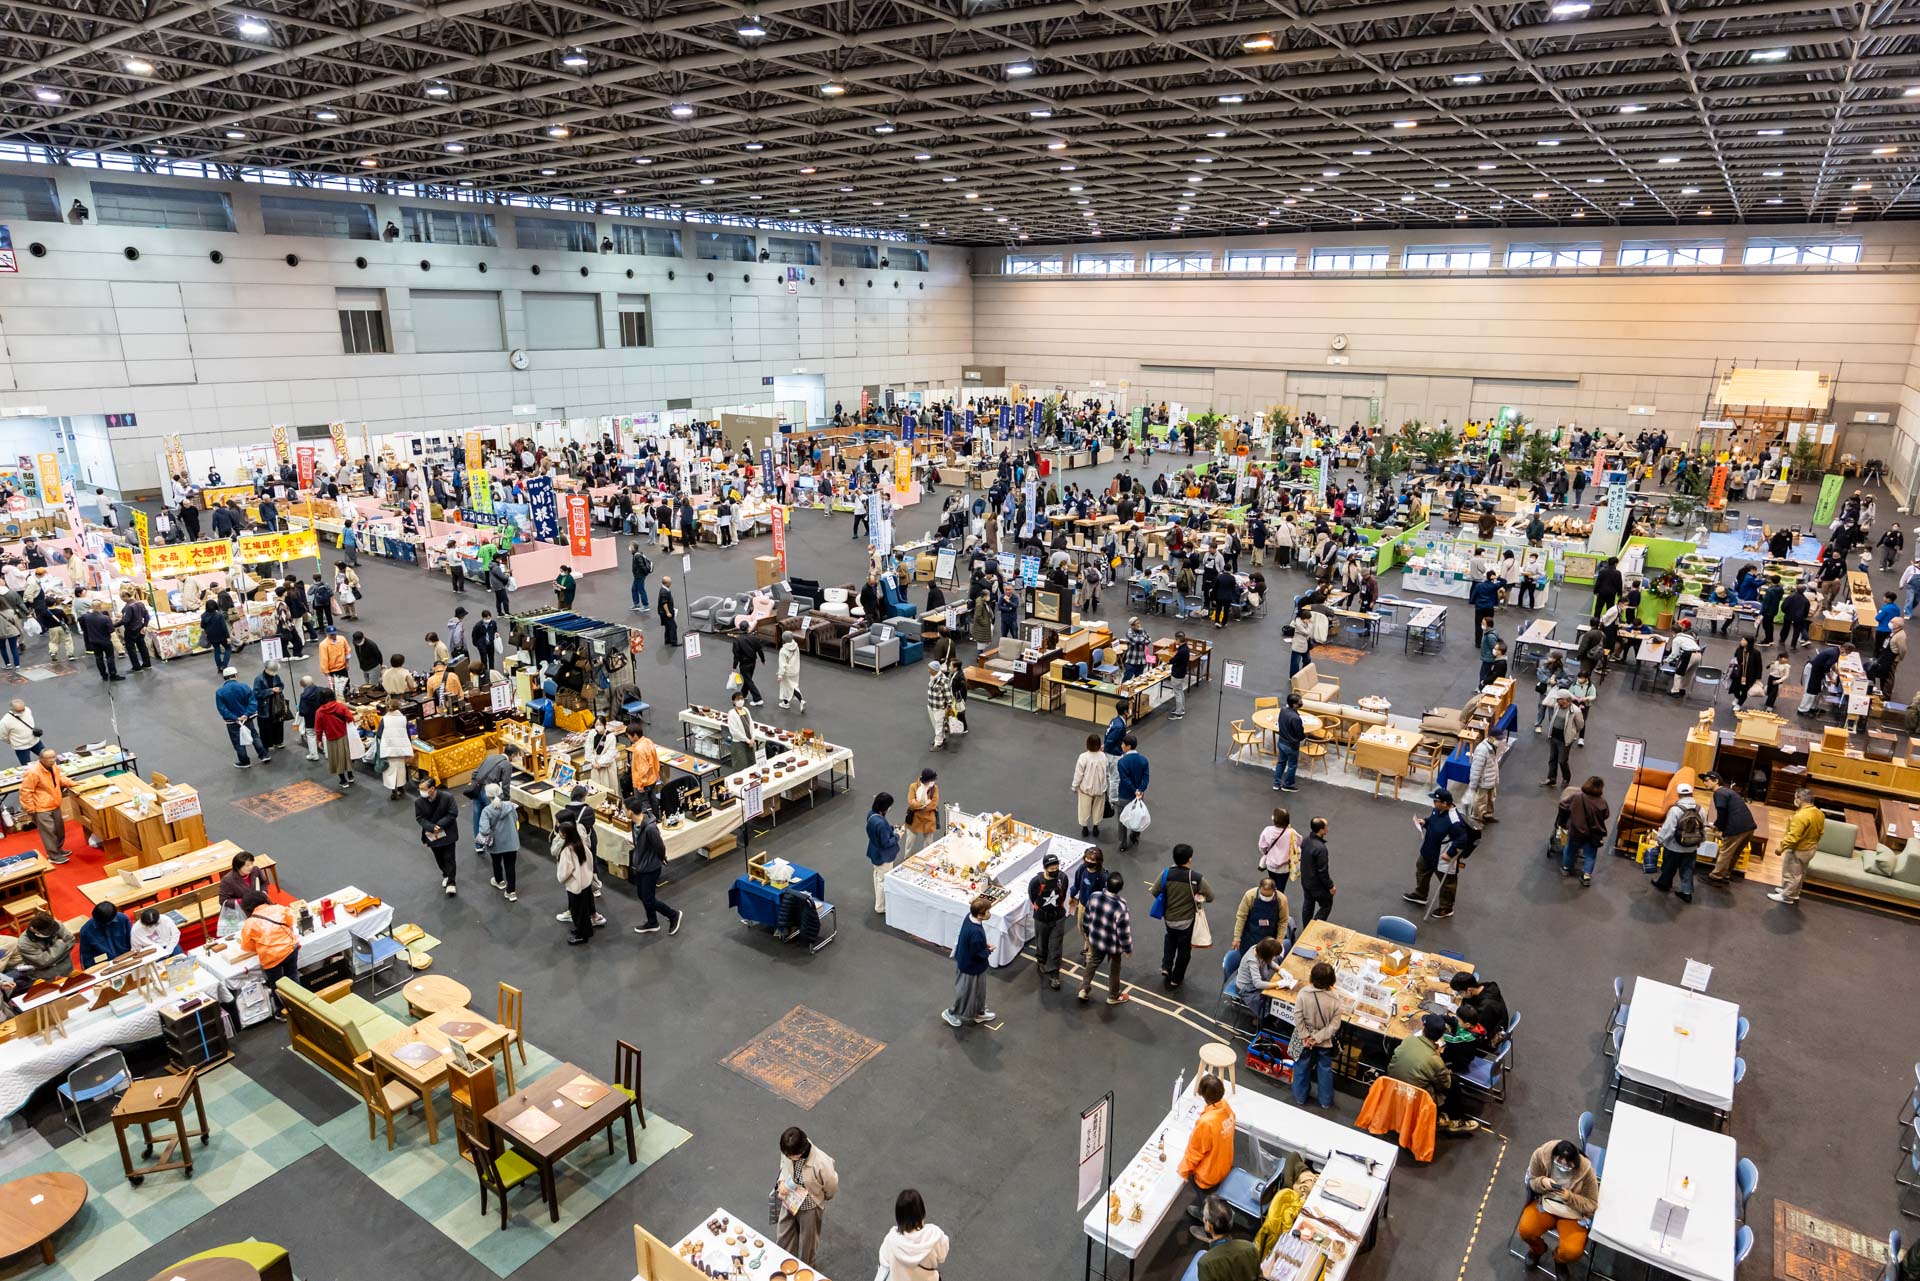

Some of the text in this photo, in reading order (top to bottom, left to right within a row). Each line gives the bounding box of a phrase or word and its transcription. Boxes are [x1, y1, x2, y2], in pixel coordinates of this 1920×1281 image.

[532, 491, 552, 538] 川根茶
[1607, 490, 1617, 532] やさしい石けん
[1614, 487, 1624, 531] 自然にも人にも
[158, 552, 180, 563] 全品
[190, 544, 227, 558] 大感謝
[243, 539, 280, 551] 工場直売
